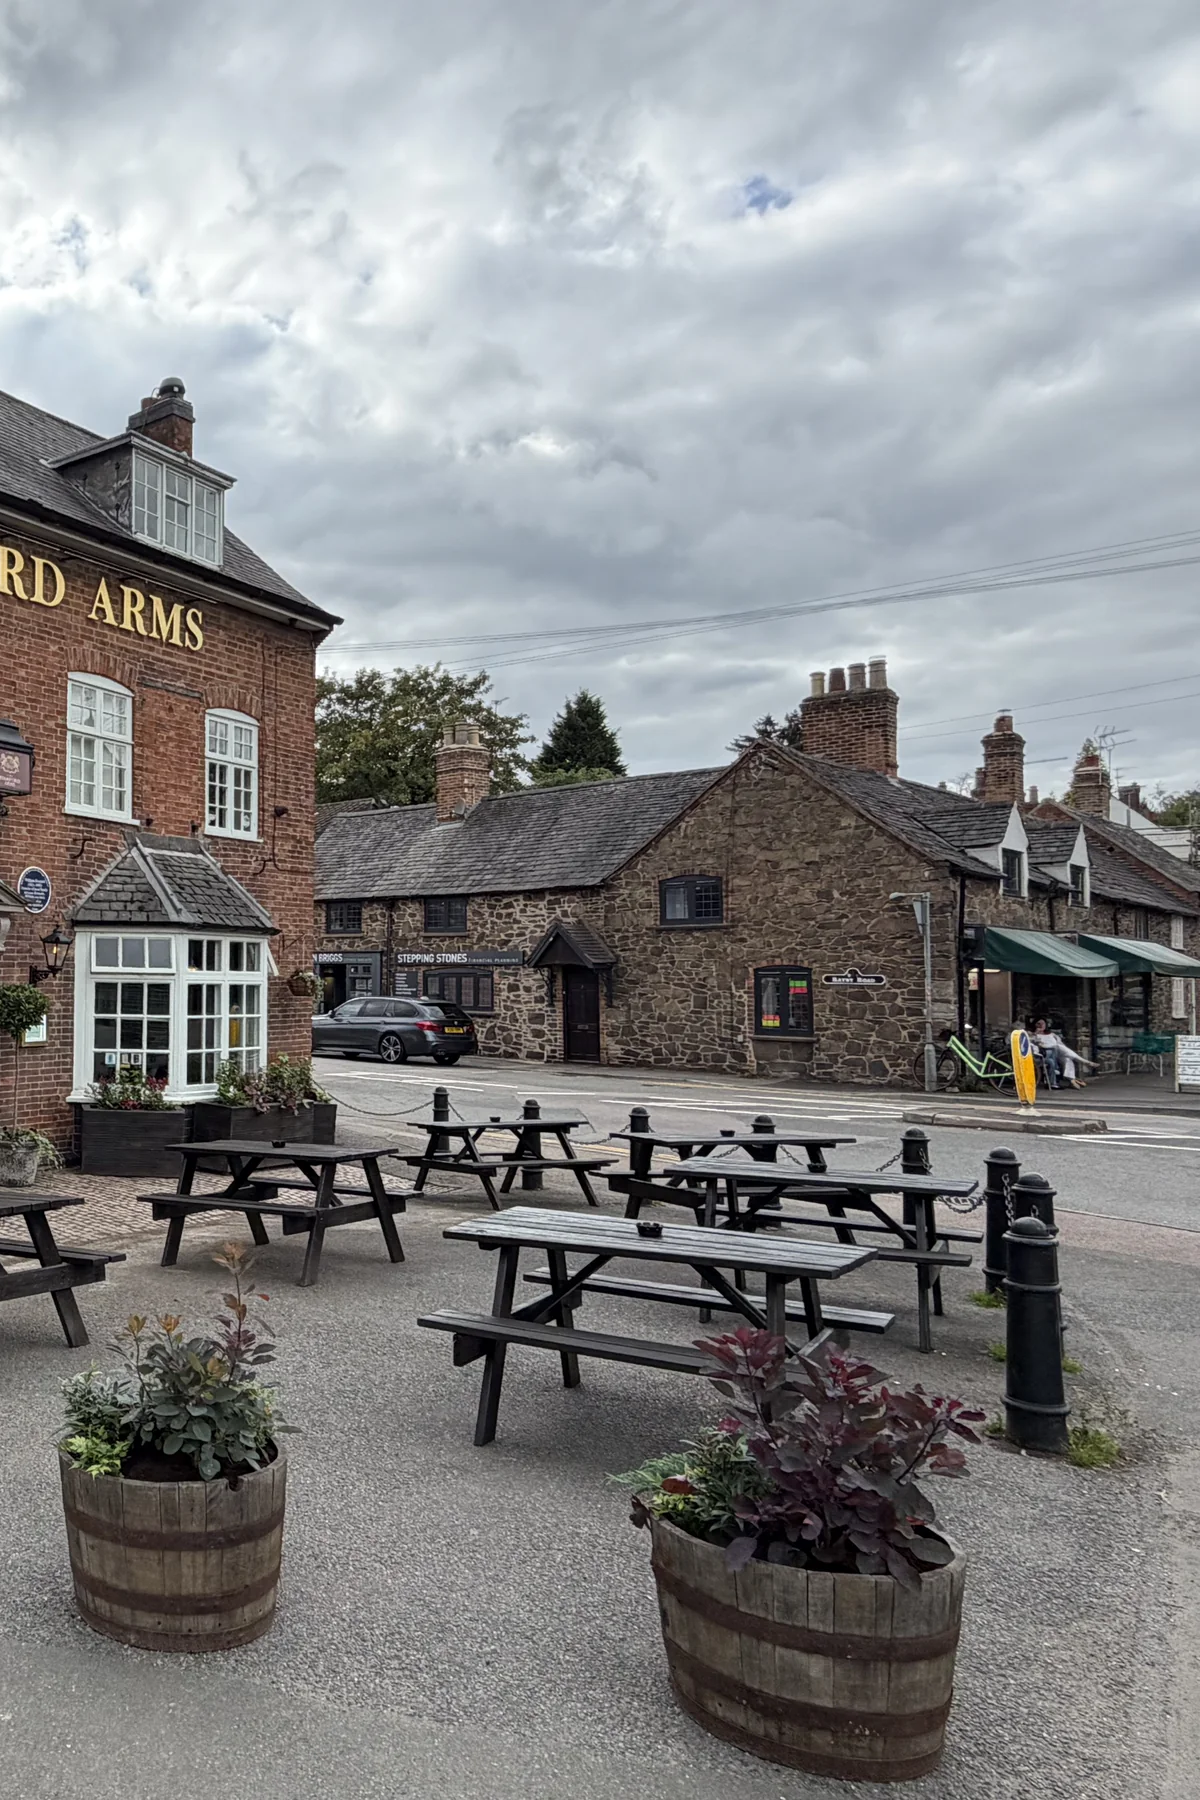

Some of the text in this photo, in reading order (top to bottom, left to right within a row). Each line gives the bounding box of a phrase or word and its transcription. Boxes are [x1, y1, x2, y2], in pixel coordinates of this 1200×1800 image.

[87, 577, 205, 653] ARMS
[318, 953, 343, 963] BRIGGS
[397, 953, 435, 963] STEPPING
[436, 953, 468, 963] STONES
